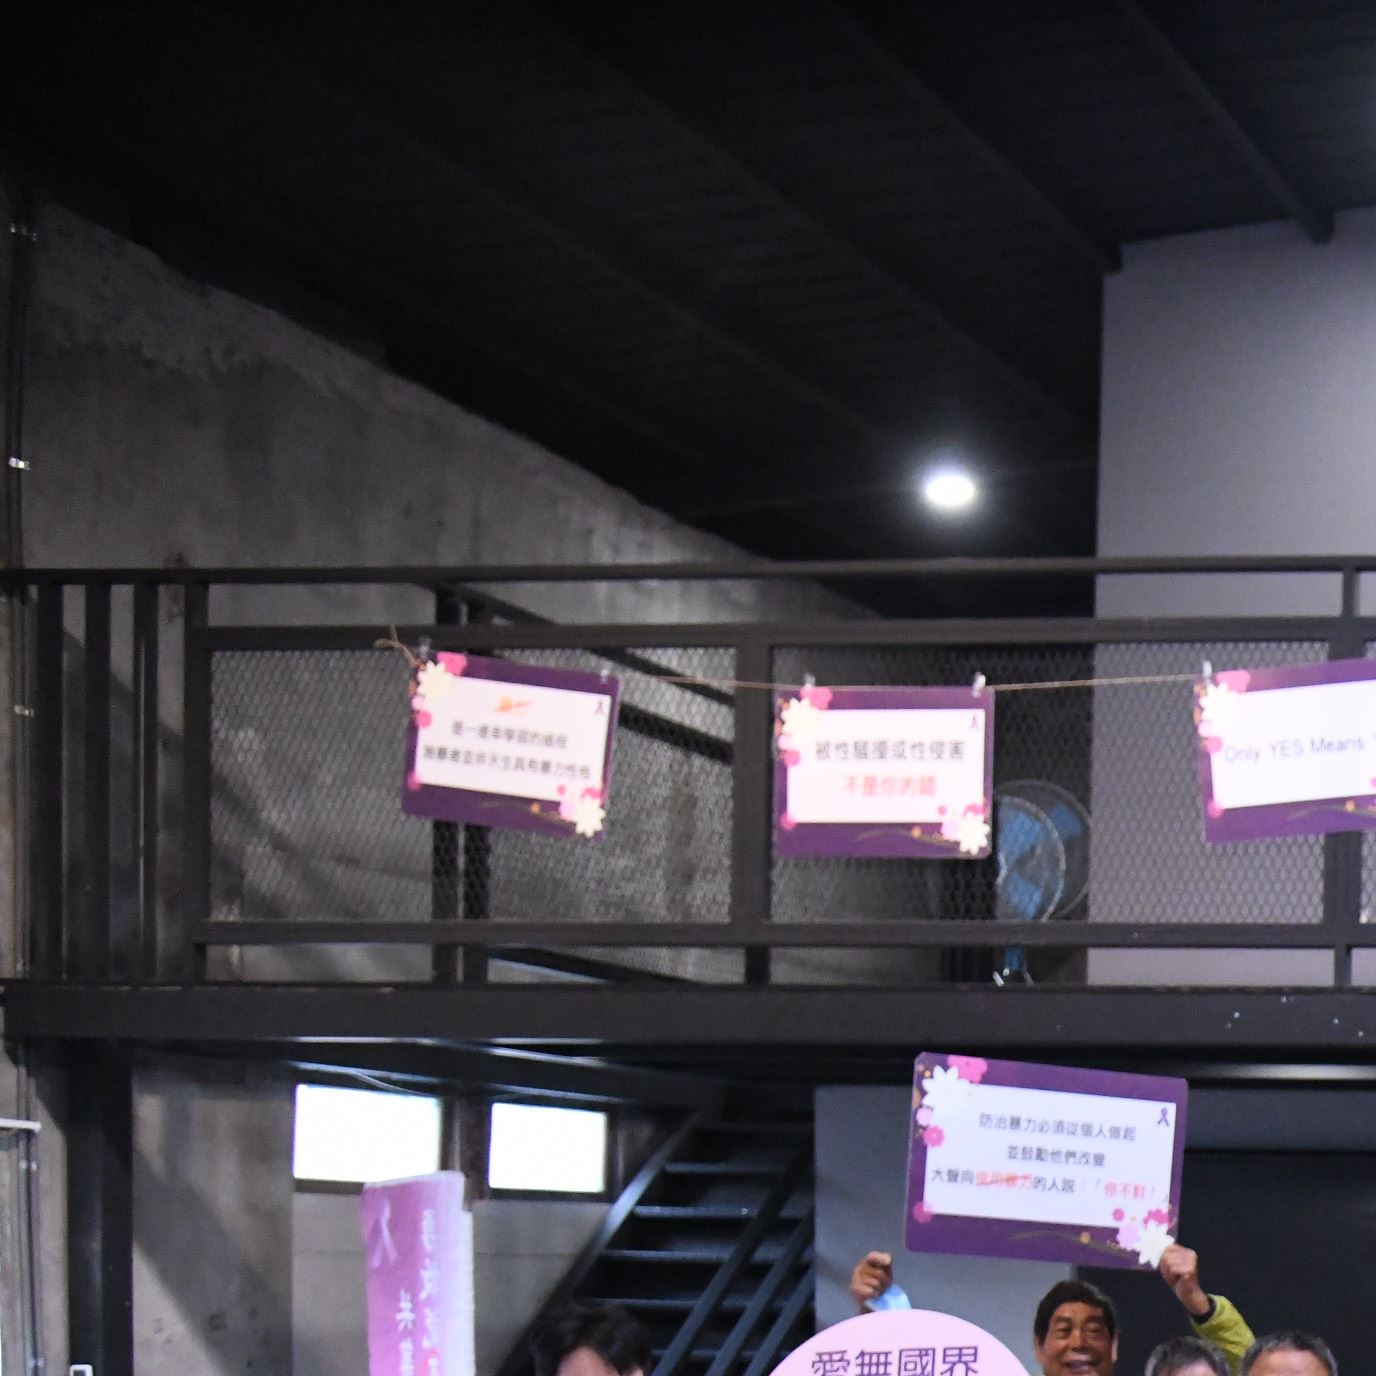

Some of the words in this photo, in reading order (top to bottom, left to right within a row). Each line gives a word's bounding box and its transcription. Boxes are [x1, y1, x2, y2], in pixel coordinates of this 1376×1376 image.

[1224, 744, 1260, 763] Only
[1271, 740, 1303, 757] YES
[1310, 737, 1364, 754] Means
